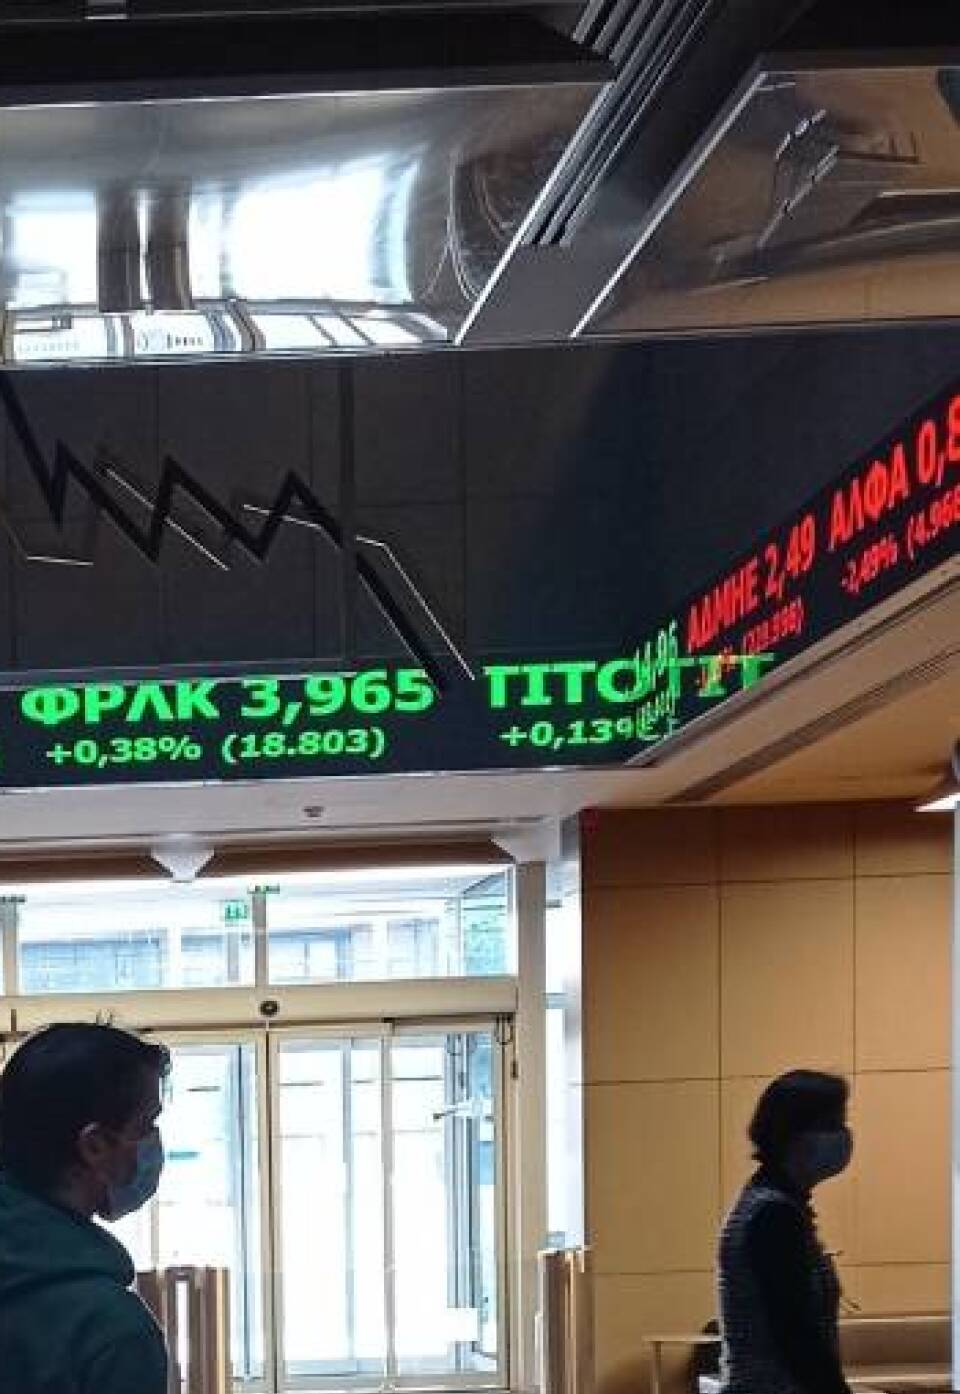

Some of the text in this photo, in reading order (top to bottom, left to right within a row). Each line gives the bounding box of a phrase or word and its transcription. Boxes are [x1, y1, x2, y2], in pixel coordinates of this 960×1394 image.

[20, 680, 220, 725] ΦΡΛΚ
[240, 669, 434, 725] 3,965
[46, 734, 201, 768] +0,38%
[221, 727, 385, 765] (18.803)
